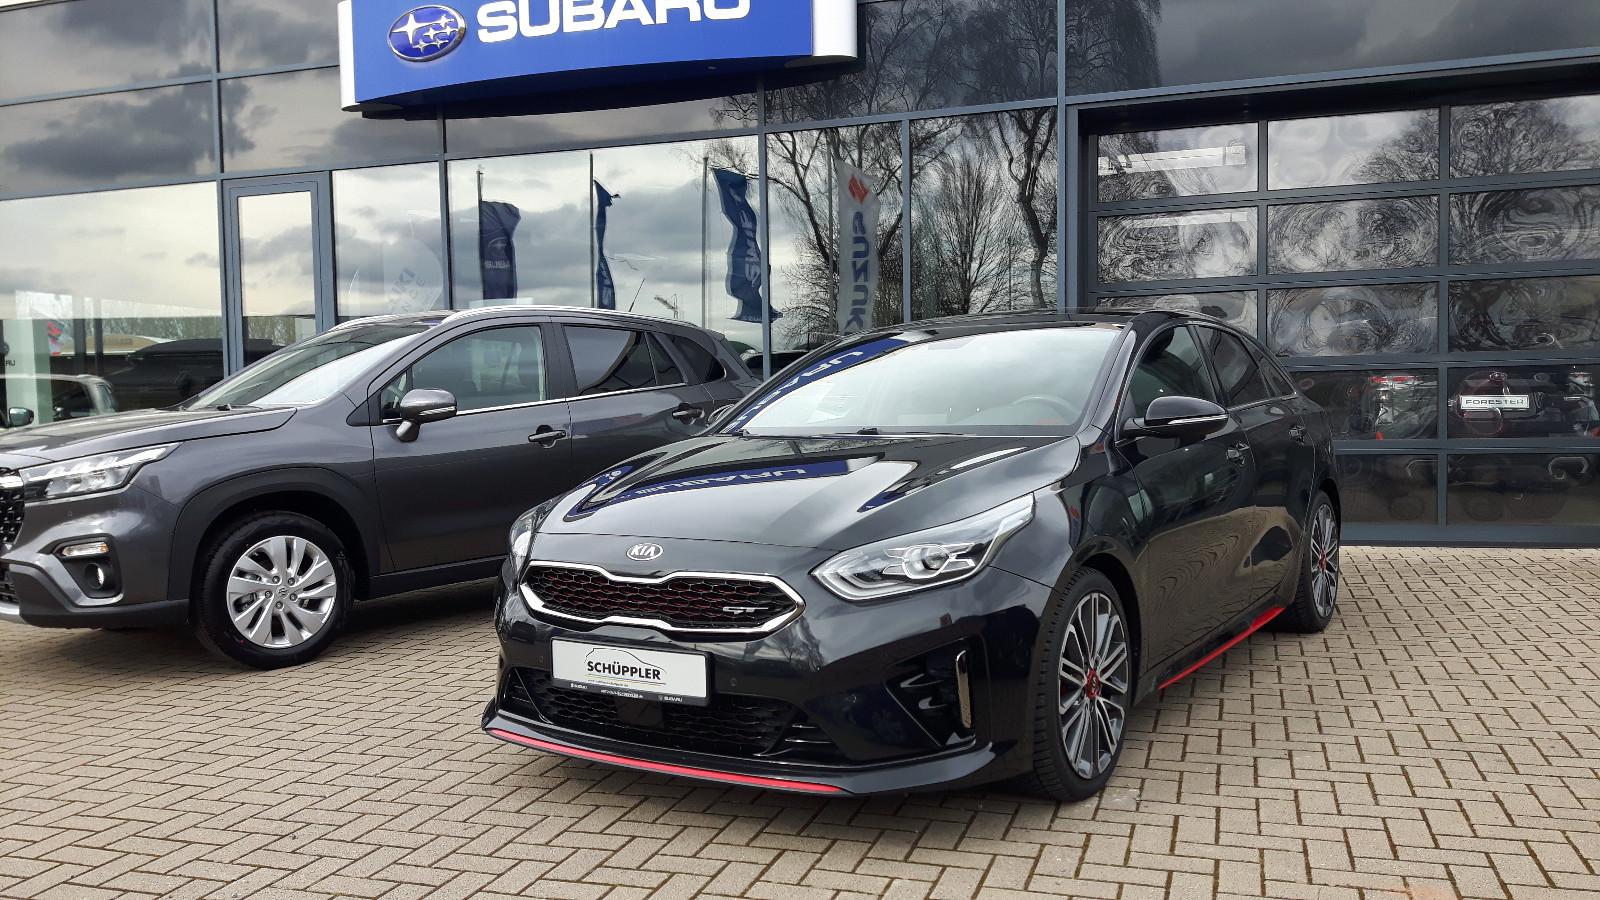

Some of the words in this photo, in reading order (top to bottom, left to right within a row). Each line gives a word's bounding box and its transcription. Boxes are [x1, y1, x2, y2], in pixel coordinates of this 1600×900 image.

[476, 0, 750, 43] SUBARU
[630, 544, 656, 557] KIA
[722, 606, 769, 615] GT
[587, 661, 661, 681] SCHÜPPLER
